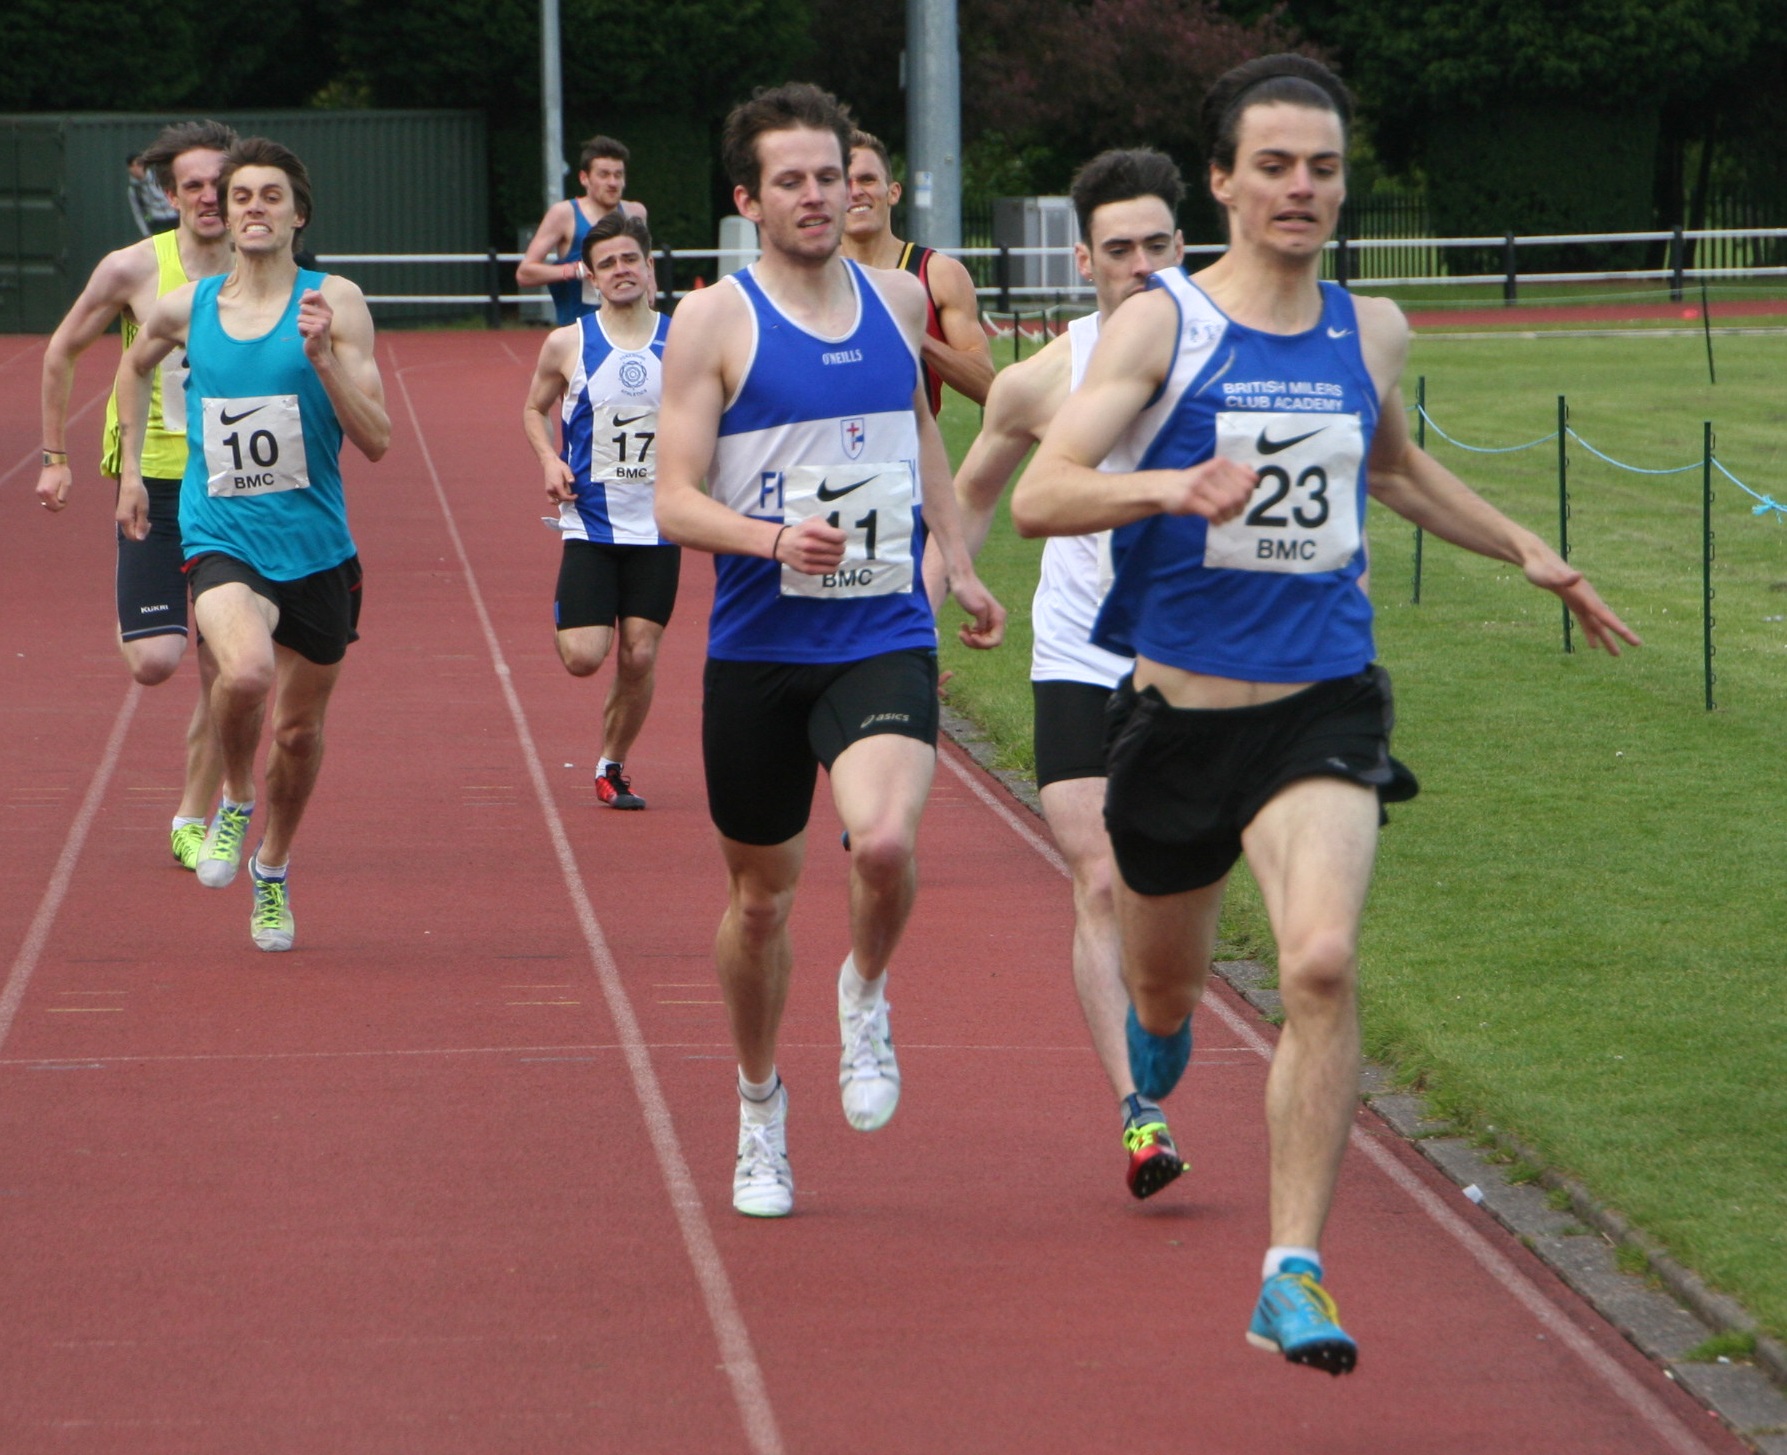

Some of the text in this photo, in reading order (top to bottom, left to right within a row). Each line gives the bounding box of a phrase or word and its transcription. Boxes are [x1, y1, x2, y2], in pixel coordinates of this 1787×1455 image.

[1222, 380, 1343, 397] BRITISH MILERS
[1225, 395, 1344, 412] CLUB ACADEMY
[222, 429, 279, 471] 10
[611, 431, 655, 463] 17
[234, 472, 275, 490] BMC
[616, 467, 648, 479] BMC
[1245, 464, 1330, 529] 23
[1256, 538, 1317, 561] BMC
[822, 568, 873, 588] BMC
[140, 604, 169, 615] KUKRI
